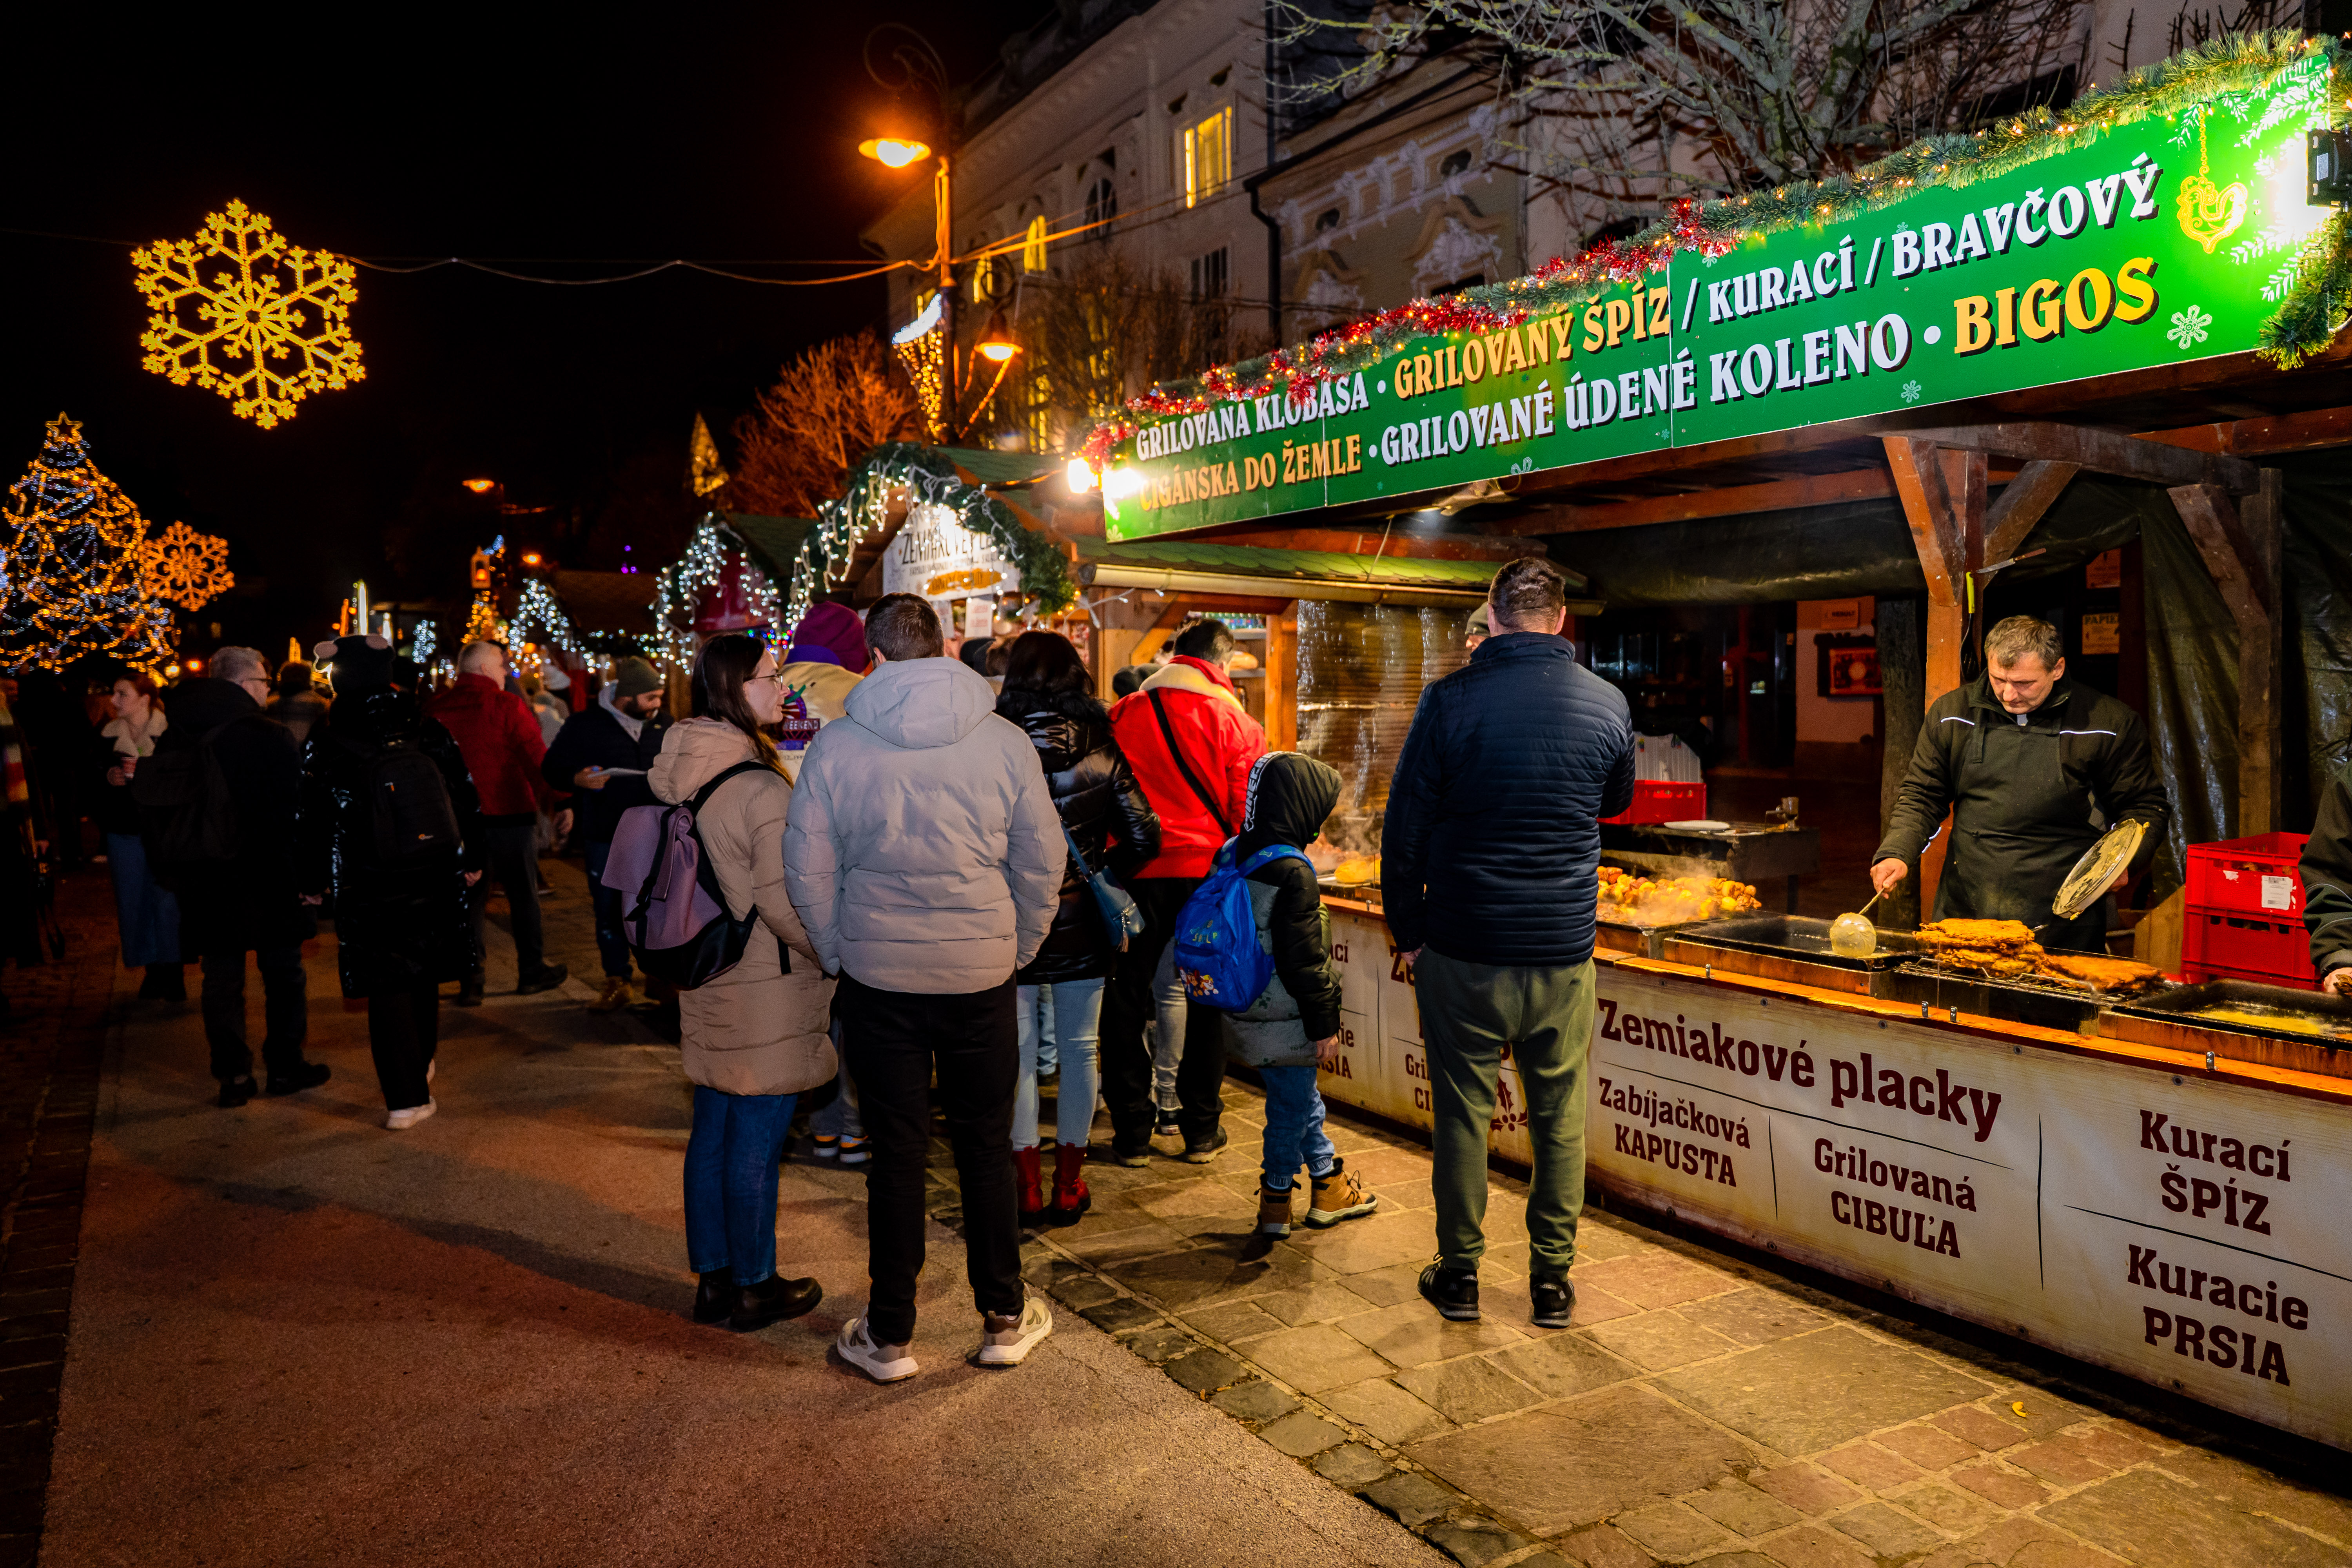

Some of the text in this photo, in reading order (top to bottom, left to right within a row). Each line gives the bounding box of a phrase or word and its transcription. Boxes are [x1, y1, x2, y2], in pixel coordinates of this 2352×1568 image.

[1395, 306, 1573, 399] GRILOVANÝ
[1583, 282, 1669, 352] ŠPÍZ
[1708, 234, 1854, 322] KURACÍ
[1892, 152, 2158, 276] BRAVČOVÝ
[1140, 257, 2154, 511] CIGÁNSKA DO ŽEMLE GRILOVANÉ ÚDENÉ KOLENO BIGOS
[1597, 998, 2001, 1142] Zemiakové placky
[1599, 1077, 1750, 1149] Zabíjačková
[2140, 1109, 2291, 1182] Kurací
[1615, 1124, 1737, 1187] KAPUSTA
[1815, 1138, 1976, 1212] Grilovaná
[1831, 1191, 1961, 1258] CIBUĽA
[2160, 1163, 2271, 1236] ŠPÍZ
[2127, 1244, 2308, 1330] Kuracie
[2143, 1306, 2290, 1387] PRSIA
